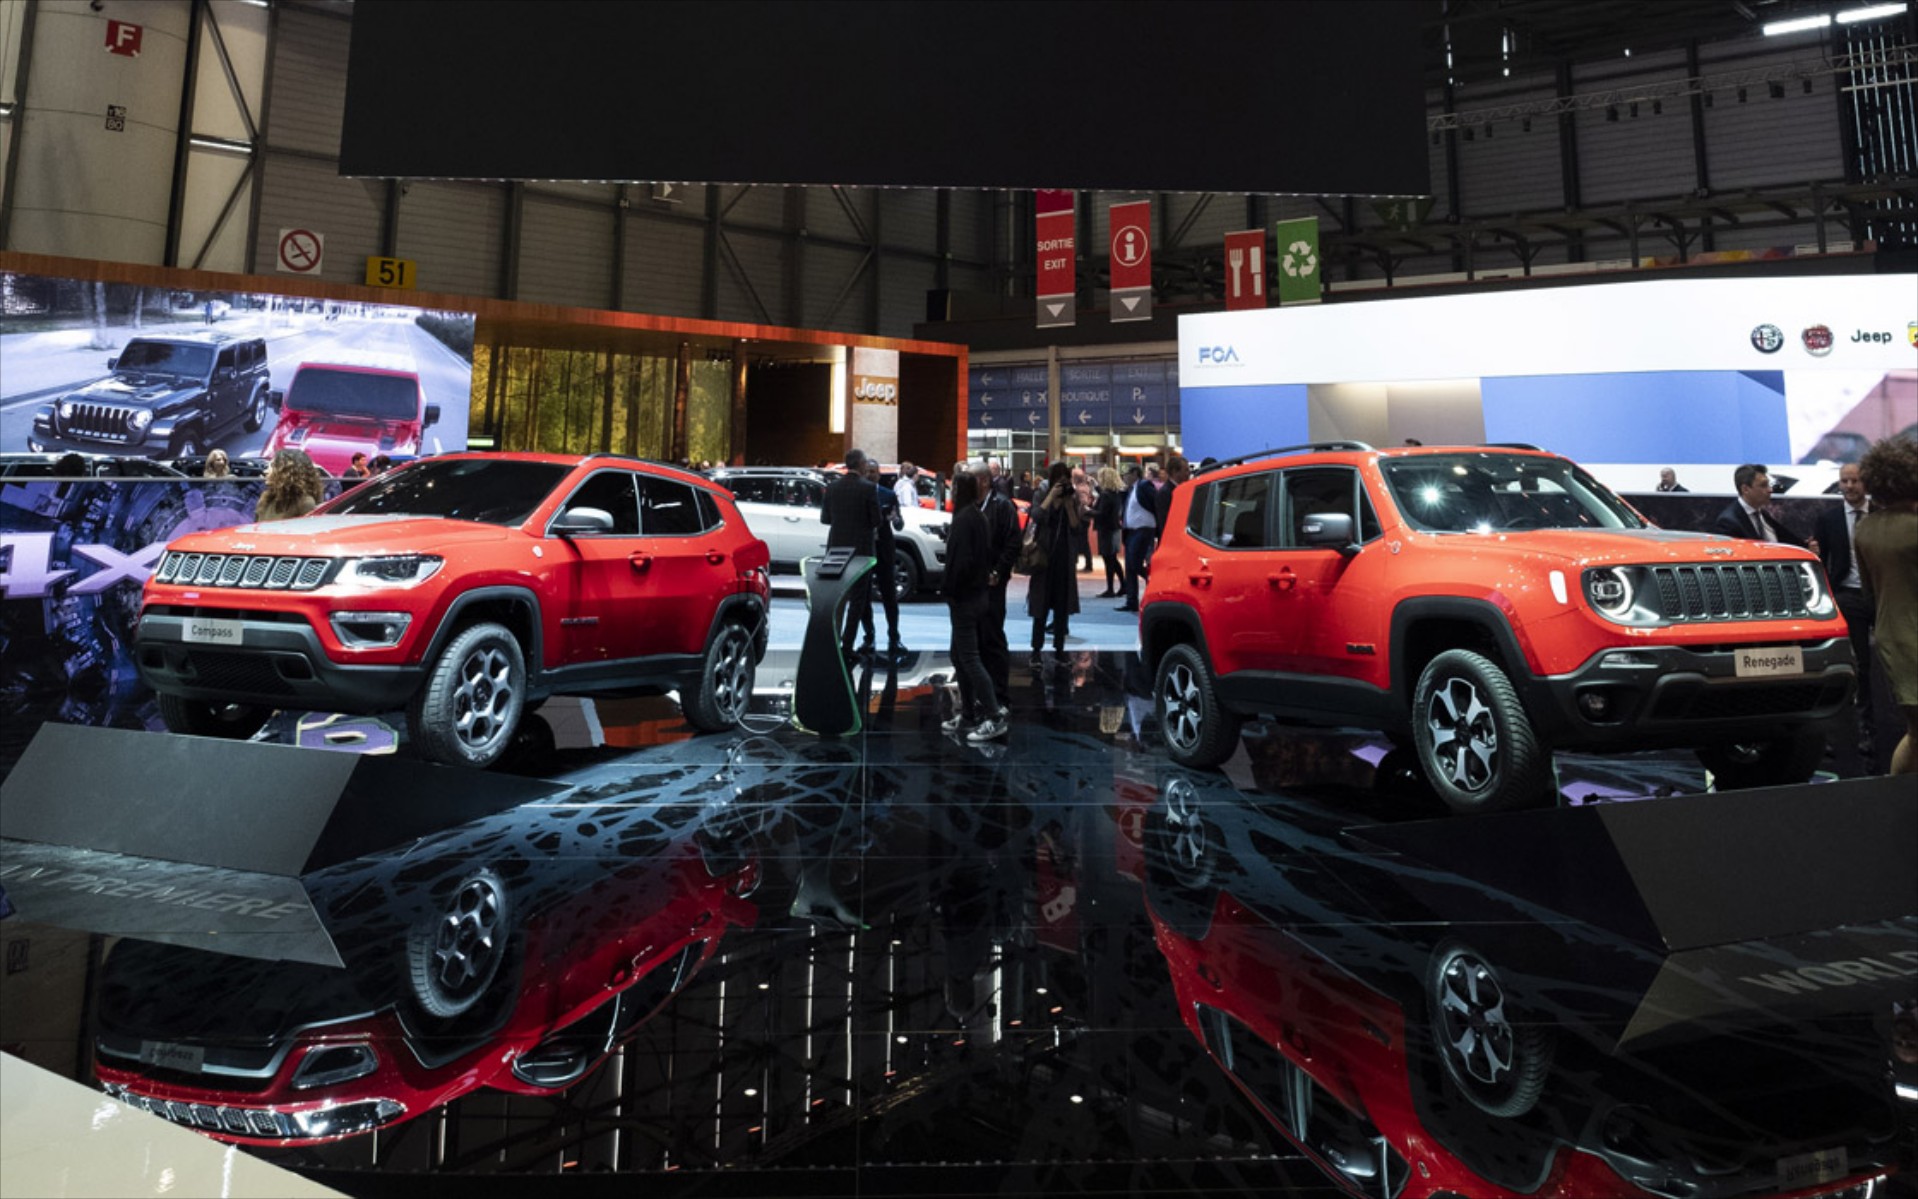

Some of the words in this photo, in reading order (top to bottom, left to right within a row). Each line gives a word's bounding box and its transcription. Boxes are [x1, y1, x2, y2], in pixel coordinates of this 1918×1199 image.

[116, 25, 136, 47] F
[1037, 238, 1074, 252] SORTIE
[1044, 259, 1066, 270] EXIT
[379, 261, 404, 285] 51
[1851, 329, 1892, 344] Jeep
[1199, 346, 1239, 364] FCA
[855, 377, 896, 402] Jeep
[191, 625, 234, 639] Compass
[1743, 655, 1795, 669] Renegade
